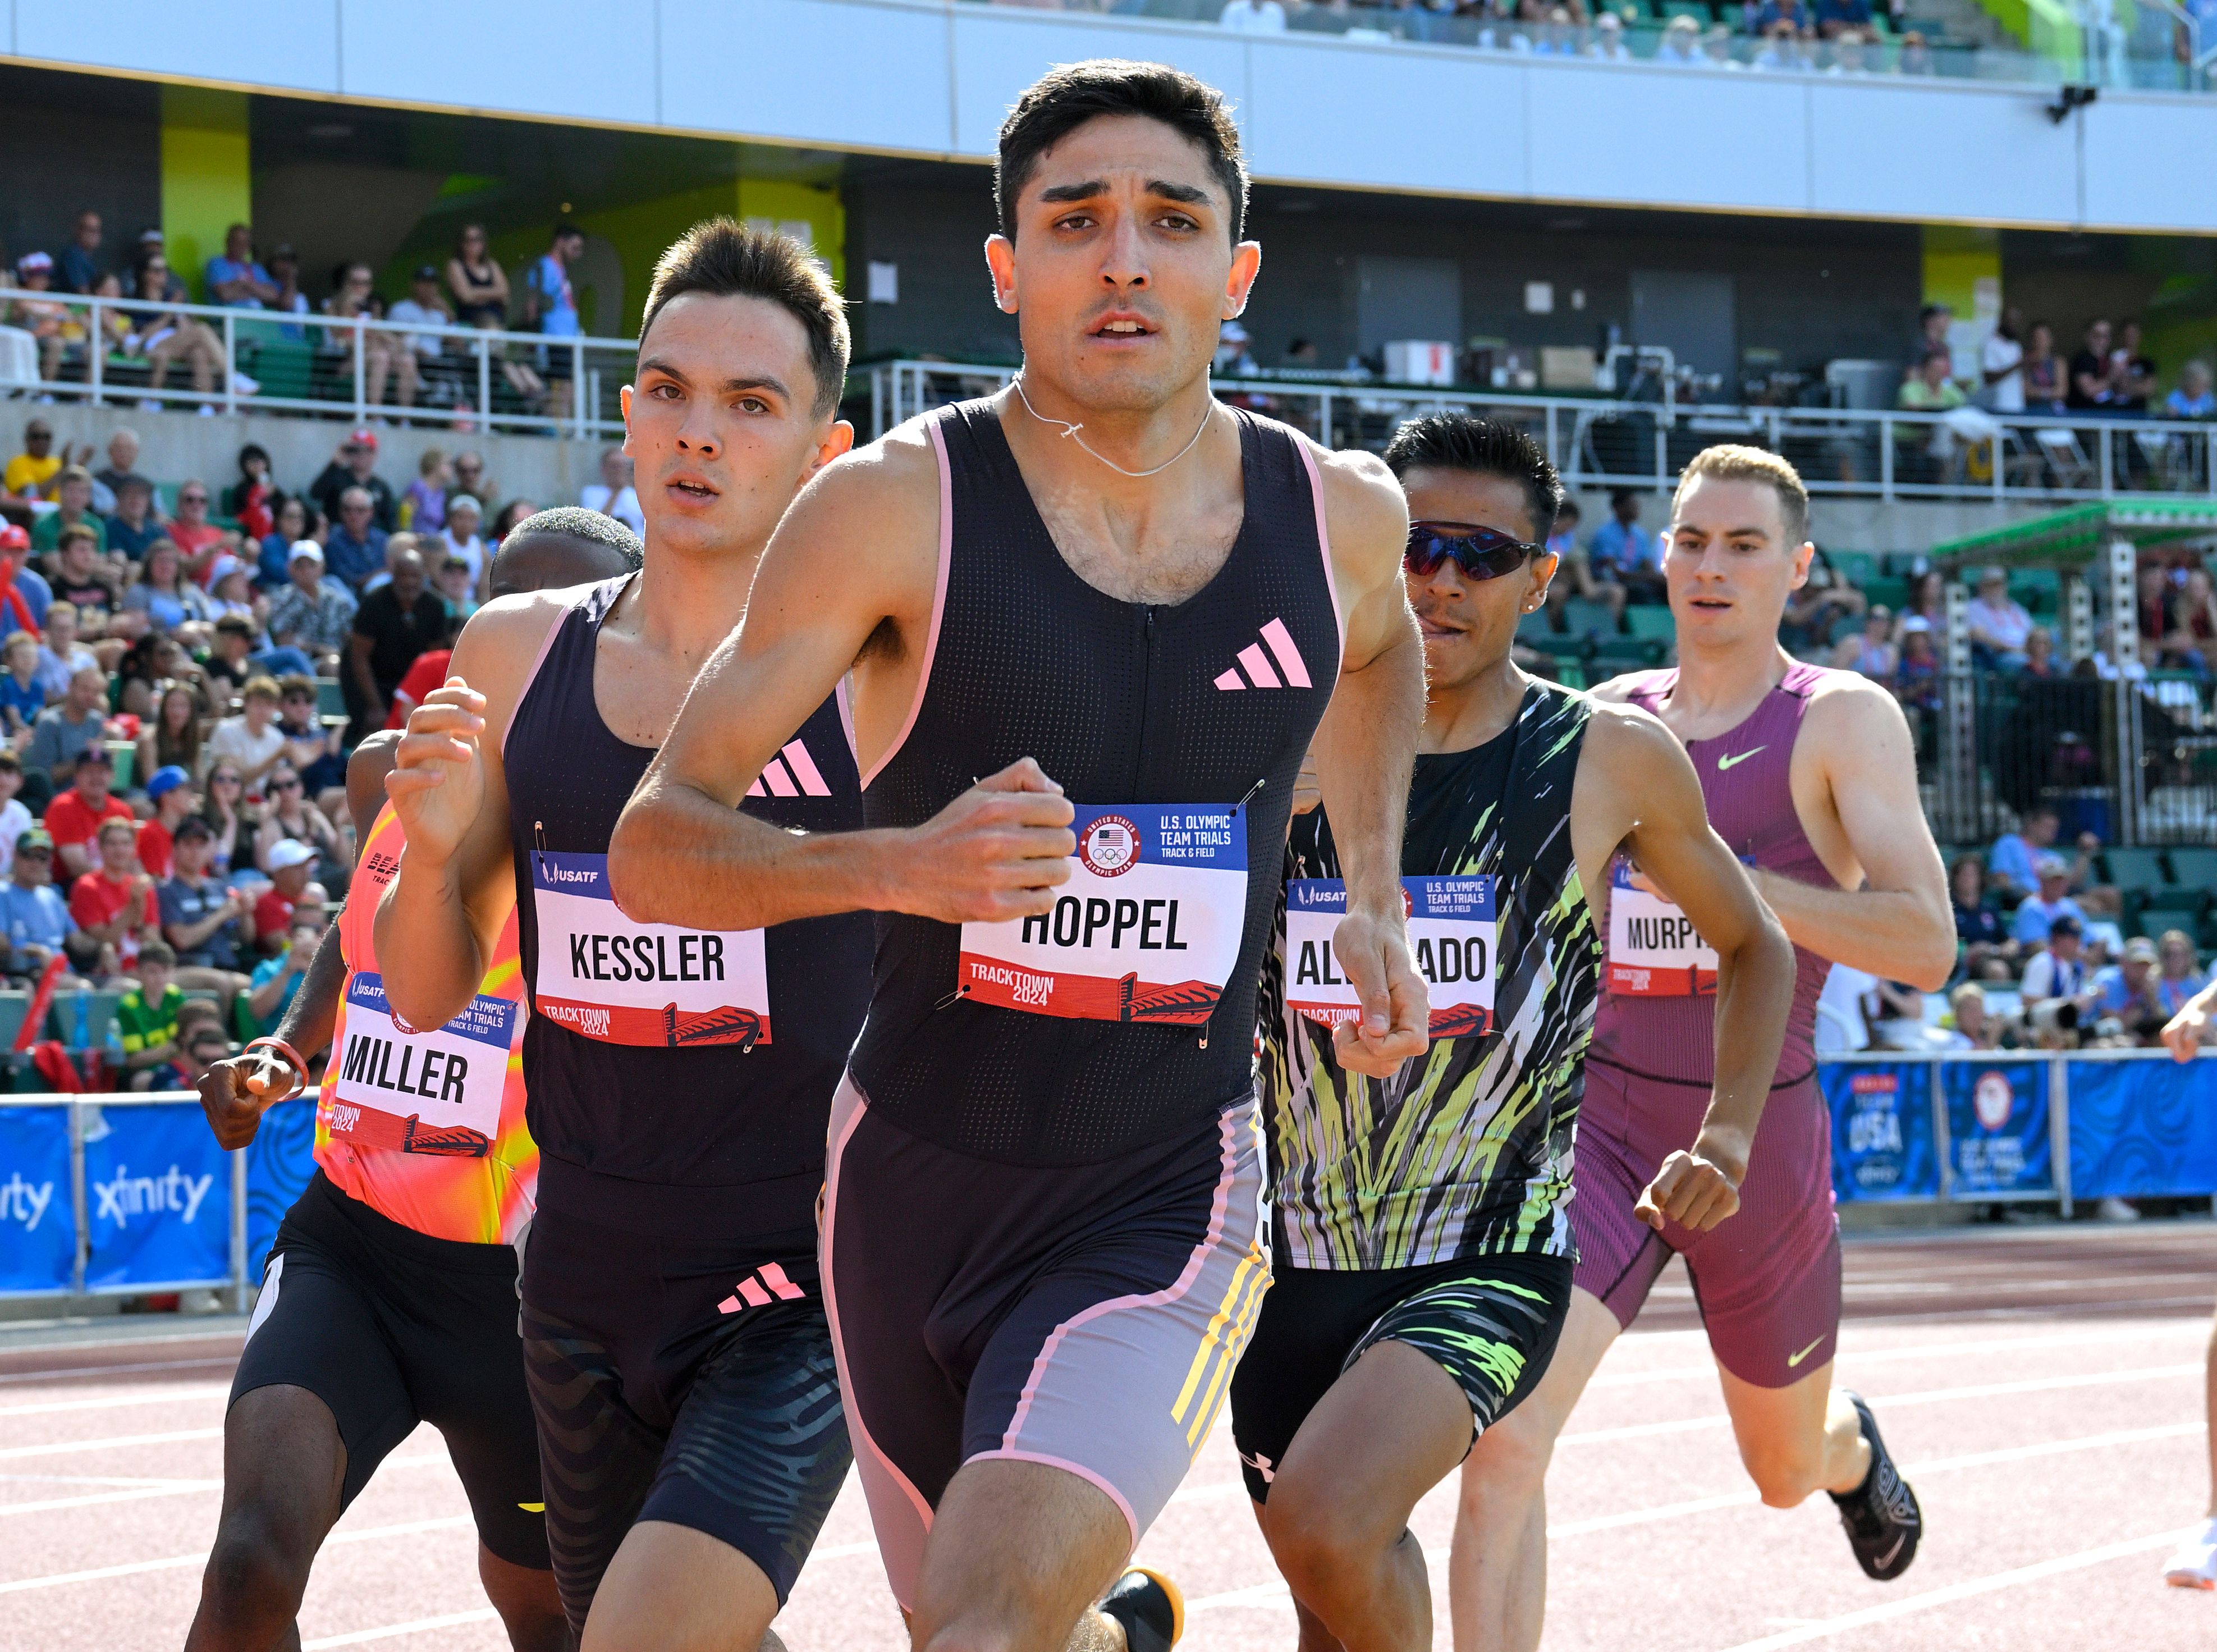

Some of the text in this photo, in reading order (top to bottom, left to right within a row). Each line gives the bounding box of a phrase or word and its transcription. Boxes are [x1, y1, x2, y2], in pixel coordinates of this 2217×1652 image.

[1087, 816, 1136, 833] UNITED STATES
[1161, 815, 1230, 829] U.S. OLYMPIC
[1160, 831, 1231, 845] TEAM TRIALS
[1161, 848, 1215, 858] TRACK & FIELD
[559, 870, 598, 882] USATF
[1085, 860, 1132, 876] OLYMPIC TEAM
[1427, 881, 1484, 893] U.S. OLYMPIC
[1315, 891, 1347, 902] USAT
[1427, 893, 1485, 904] TEAM TRIALS
[1022, 895, 1187, 950] HOPPEL
[570, 933, 725, 982] KESSLER
[1297, 937, 1486, 985] ALADO
[970, 963, 1053, 994] TRACKTOWN
[359, 985, 385, 997] USATF
[1013, 986, 1047, 1006] 2024
[469, 1000, 505, 1016] OLYMPIC
[544, 1005, 610, 1024] TRACKTOWN
[474, 1012, 503, 1028] TRIALS
[473, 1024, 488, 1035] FIELD
[581, 1021, 608, 1036] 2024
[342, 1034, 468, 1104] MILLER
[333, 1104, 361, 1122] TOWN
[332, 1116, 353, 1132] 2024
[93, 1164, 213, 1229] xfinity
